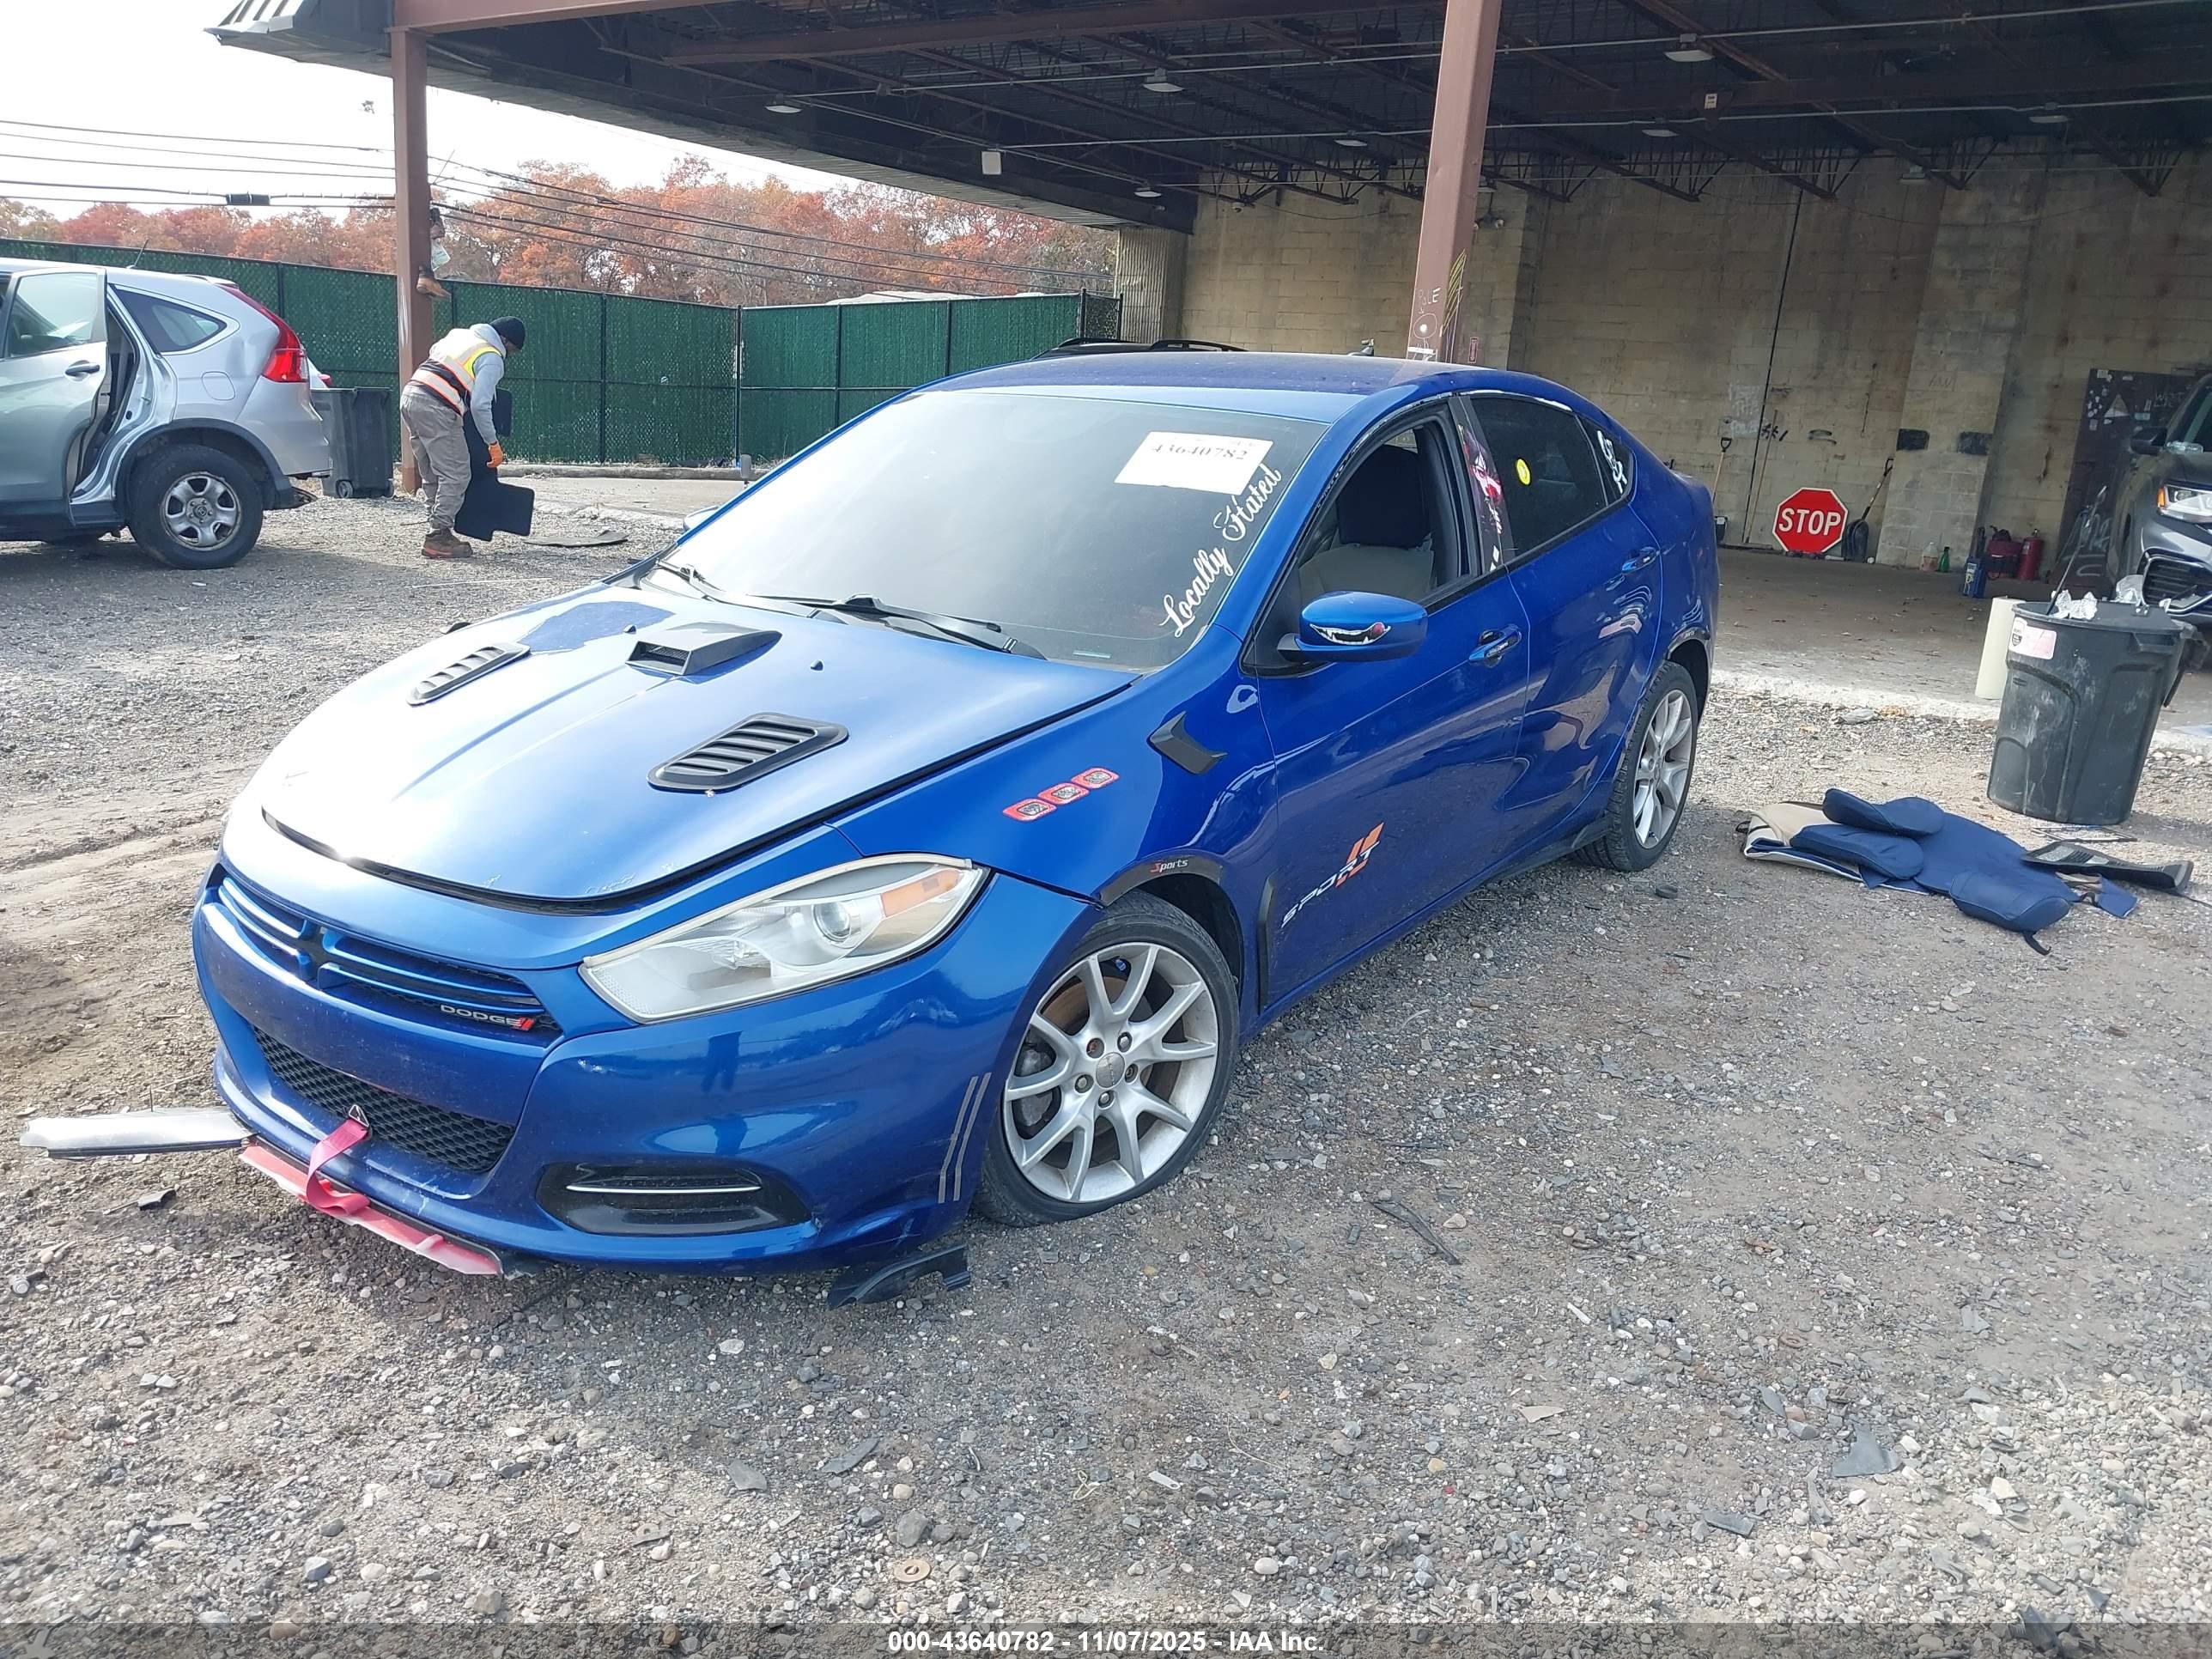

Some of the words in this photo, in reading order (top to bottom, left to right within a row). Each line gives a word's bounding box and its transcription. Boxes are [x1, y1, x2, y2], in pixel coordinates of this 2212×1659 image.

[1152, 443, 1249, 461] 43640782
[1778, 507, 1842, 537] STOP
[1159, 547, 1234, 638] Locally
[1212, 464, 1282, 542] Hated
[1150, 859, 1189, 874] Sports
[1281, 841, 1381, 929] SPORT
[440, 1004, 522, 1028] DODGE
